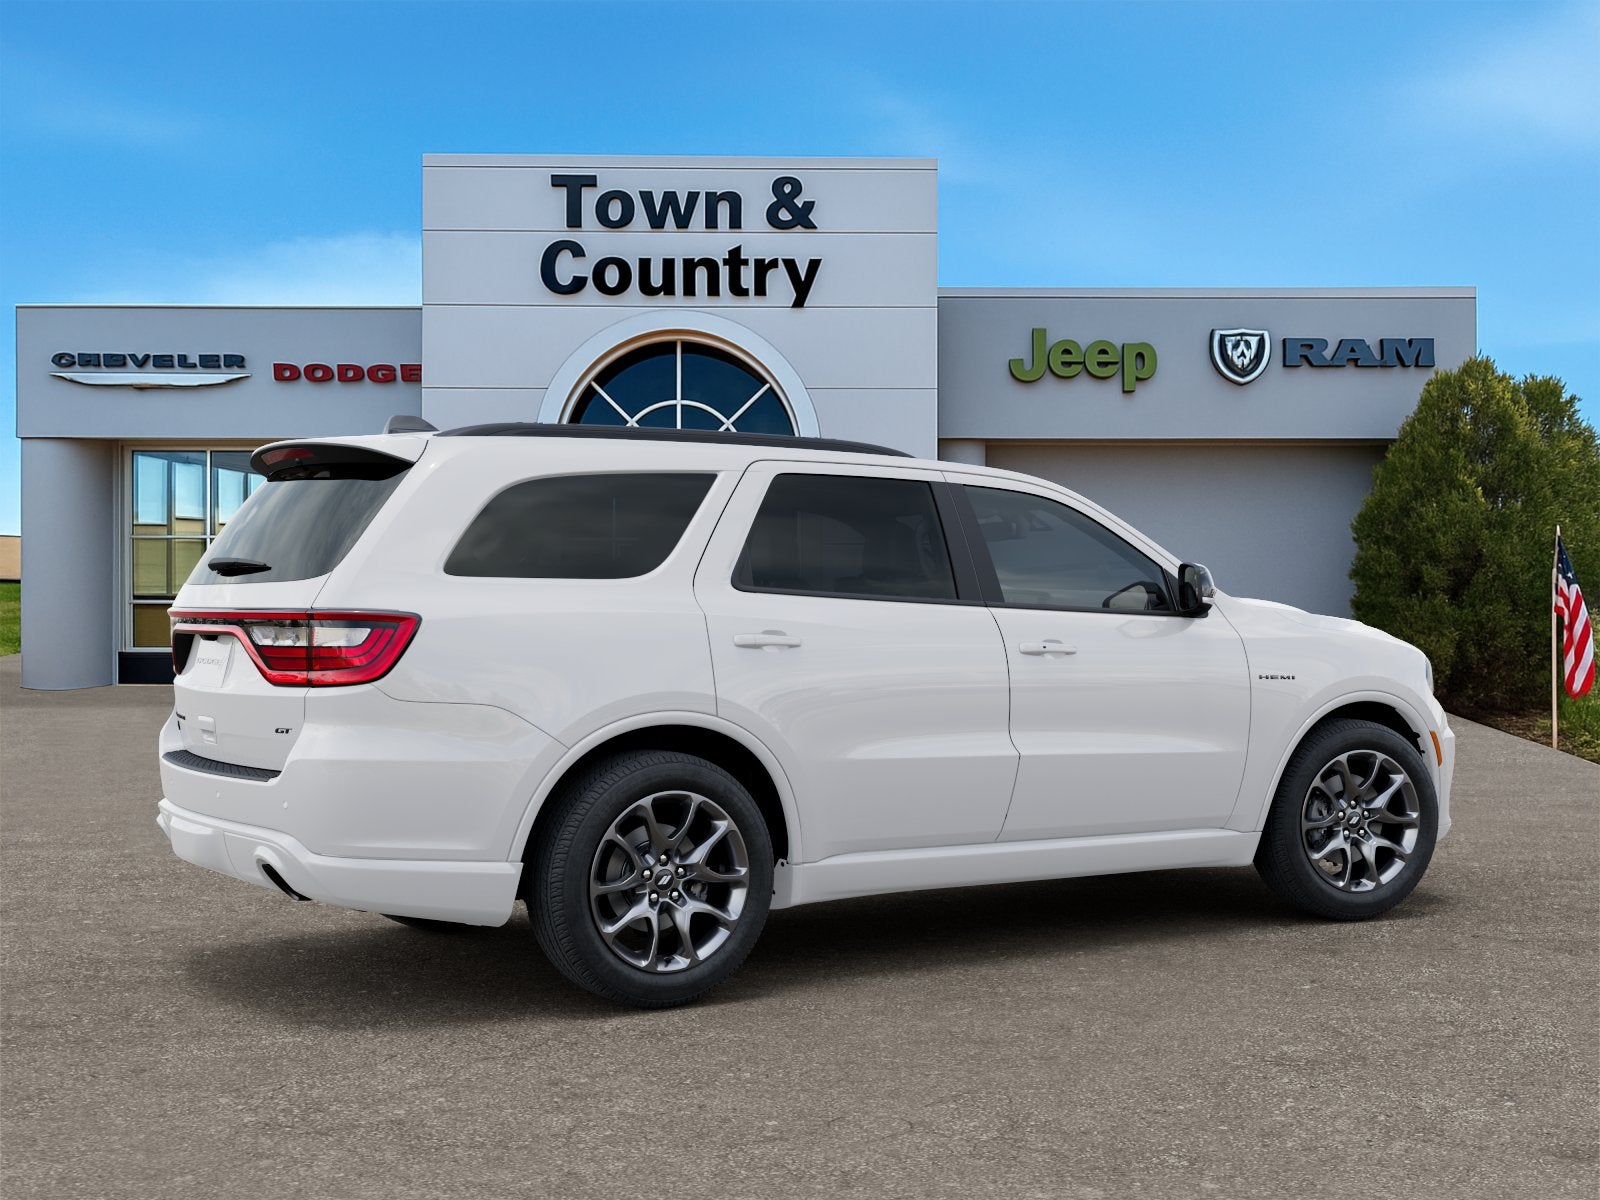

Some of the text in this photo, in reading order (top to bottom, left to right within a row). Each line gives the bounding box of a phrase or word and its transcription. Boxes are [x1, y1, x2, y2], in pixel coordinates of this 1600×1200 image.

[550, 173, 818, 230] Town &
[539, 239, 823, 308] Country
[272, 362, 422, 383] DODGE
[1008, 327, 1158, 393] Jeep
[1282, 337, 1436, 368] RAM
[274, 727, 293, 735] GT
